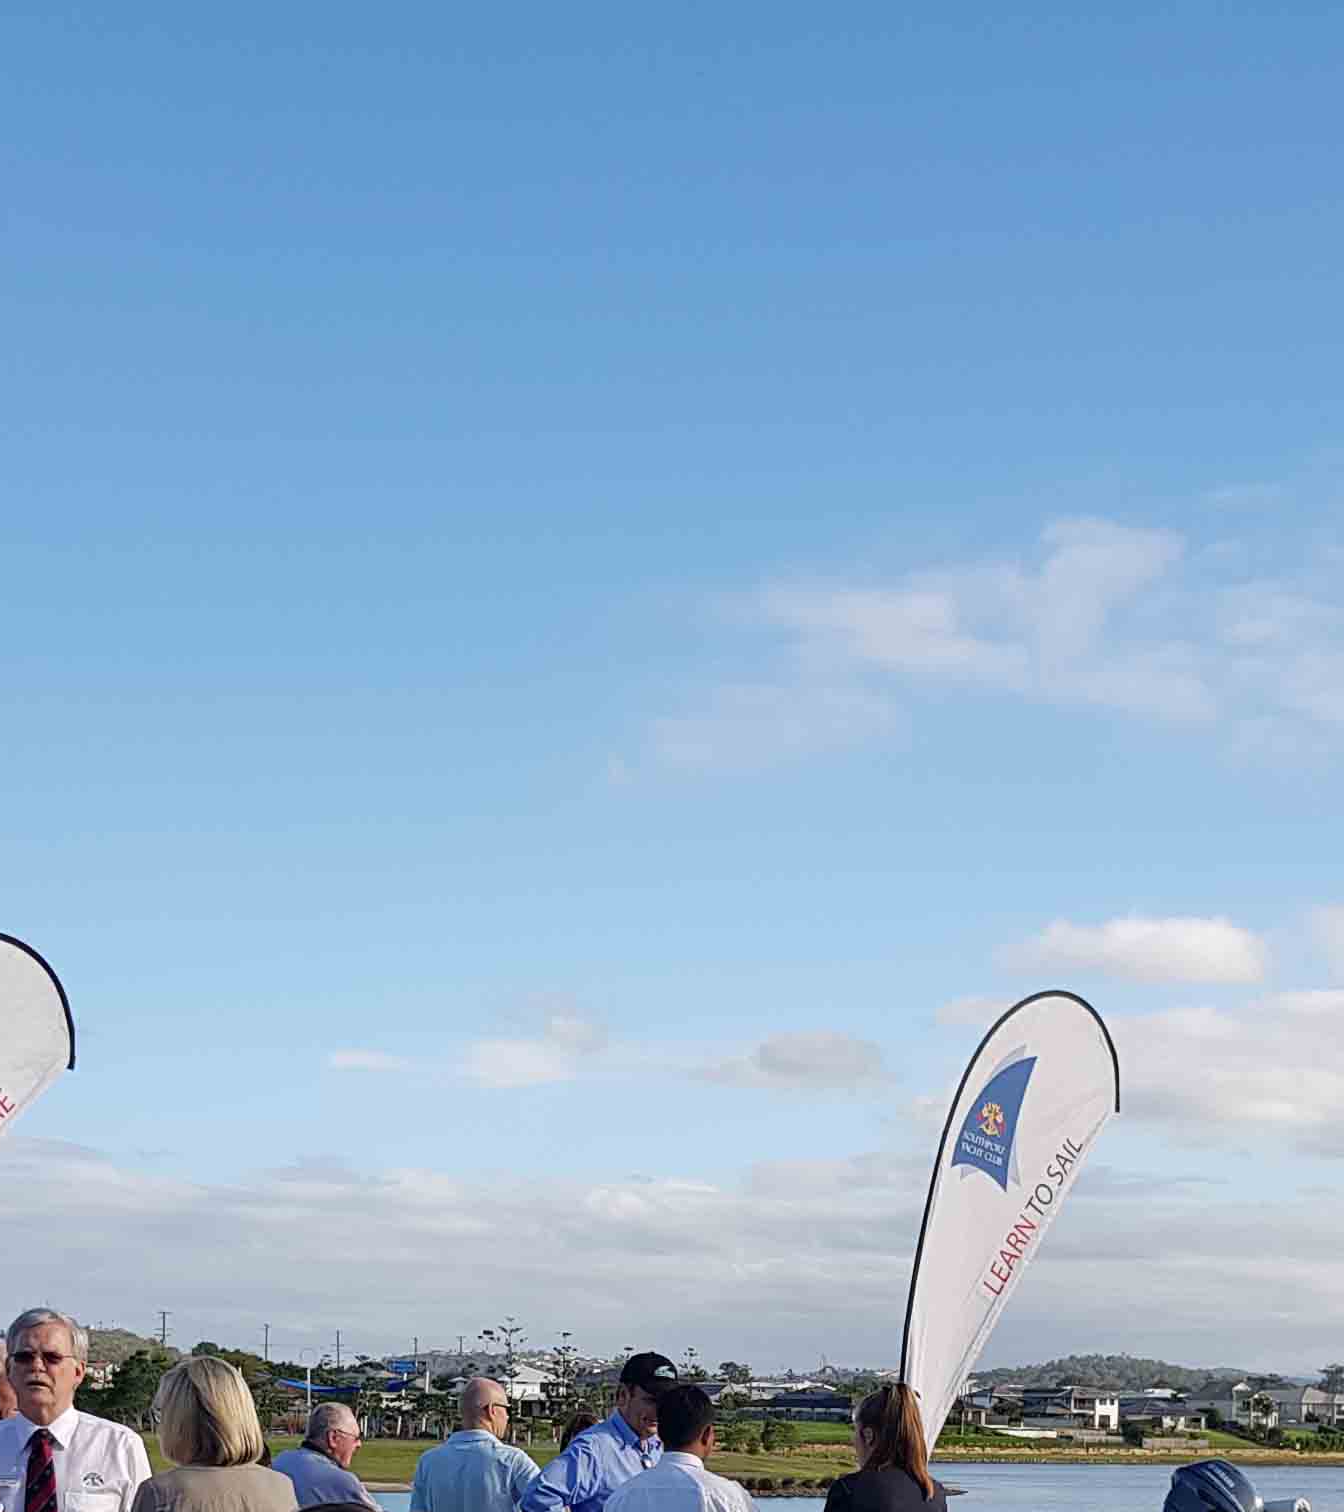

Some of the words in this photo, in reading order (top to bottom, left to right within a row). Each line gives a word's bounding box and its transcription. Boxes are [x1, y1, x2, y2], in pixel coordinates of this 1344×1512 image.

[983, 1214, 1037, 1296] LEARN
[1024, 1183, 1053, 1216] TO
[1046, 1137, 1084, 1186] SAIL
